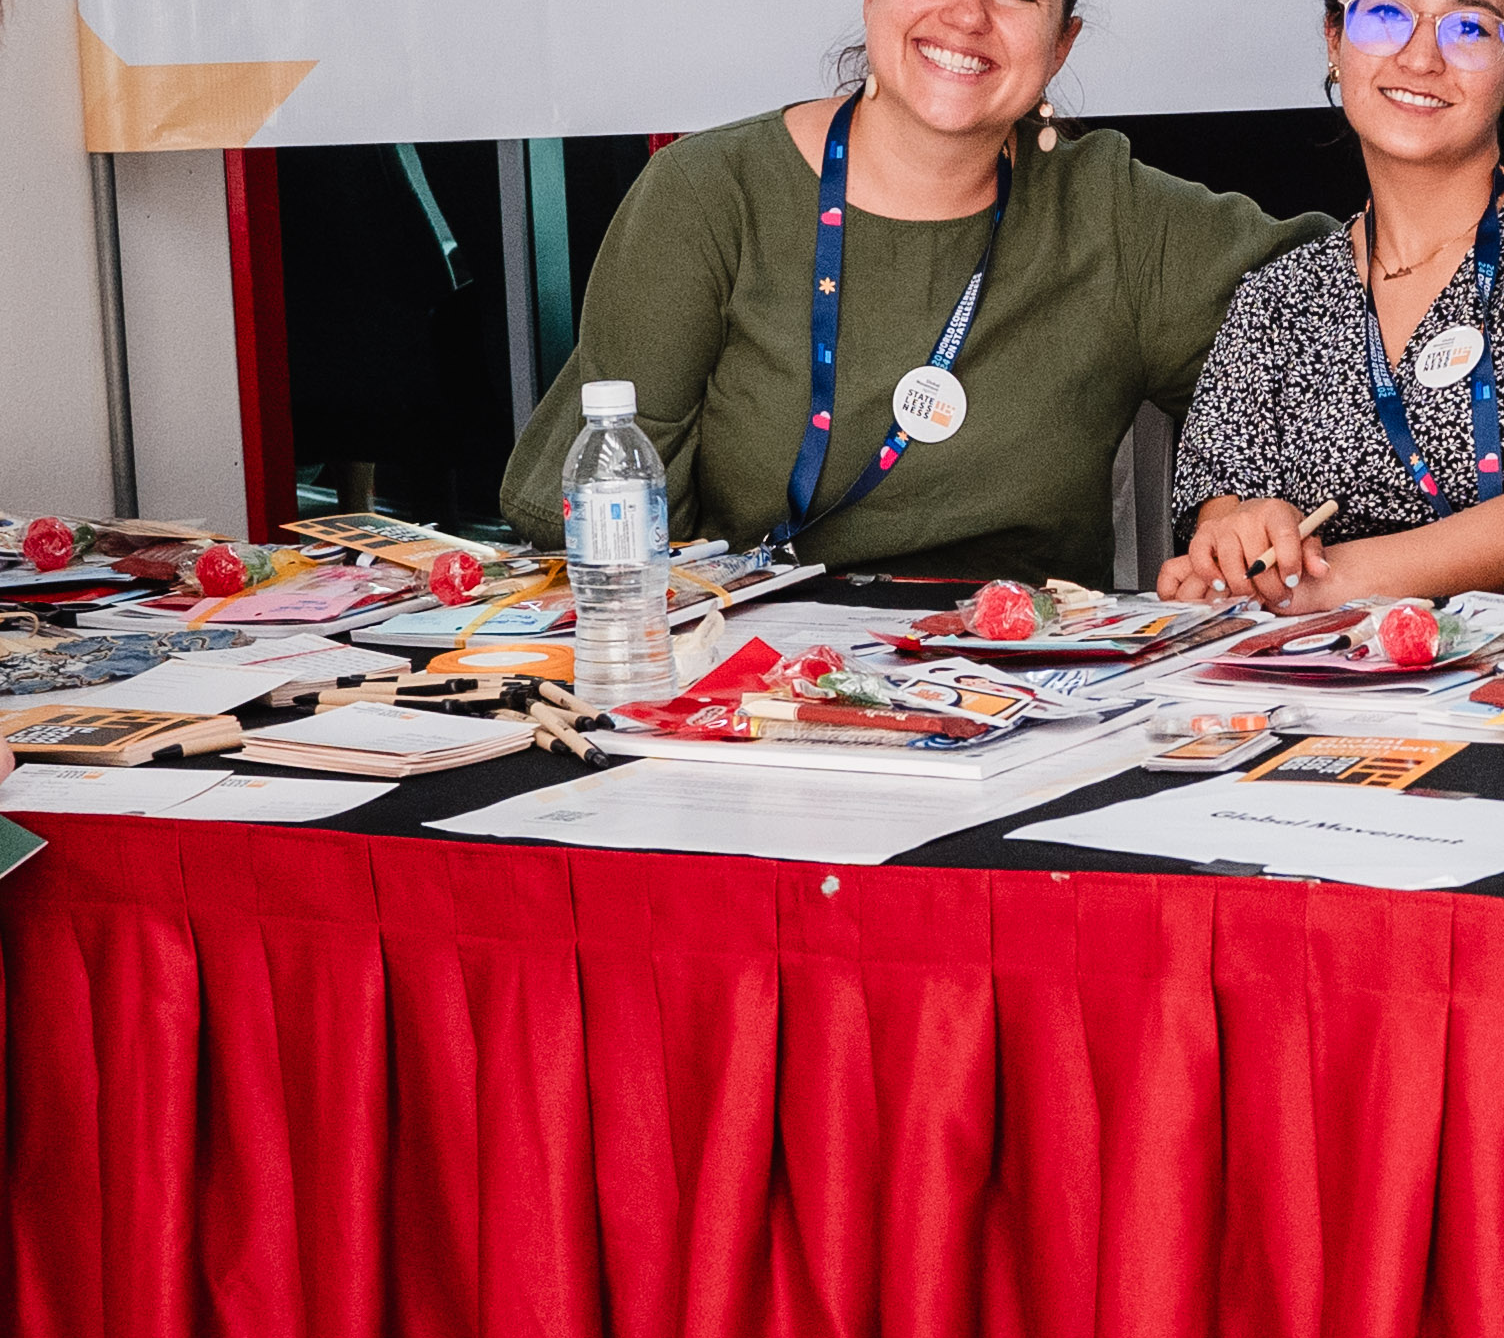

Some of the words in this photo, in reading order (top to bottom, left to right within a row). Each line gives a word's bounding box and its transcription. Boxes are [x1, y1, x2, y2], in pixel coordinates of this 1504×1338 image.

[908, 389, 934, 403] STATE
[1210, 810, 1307, 827] Global
[1308, 820, 1464, 845] Movement
